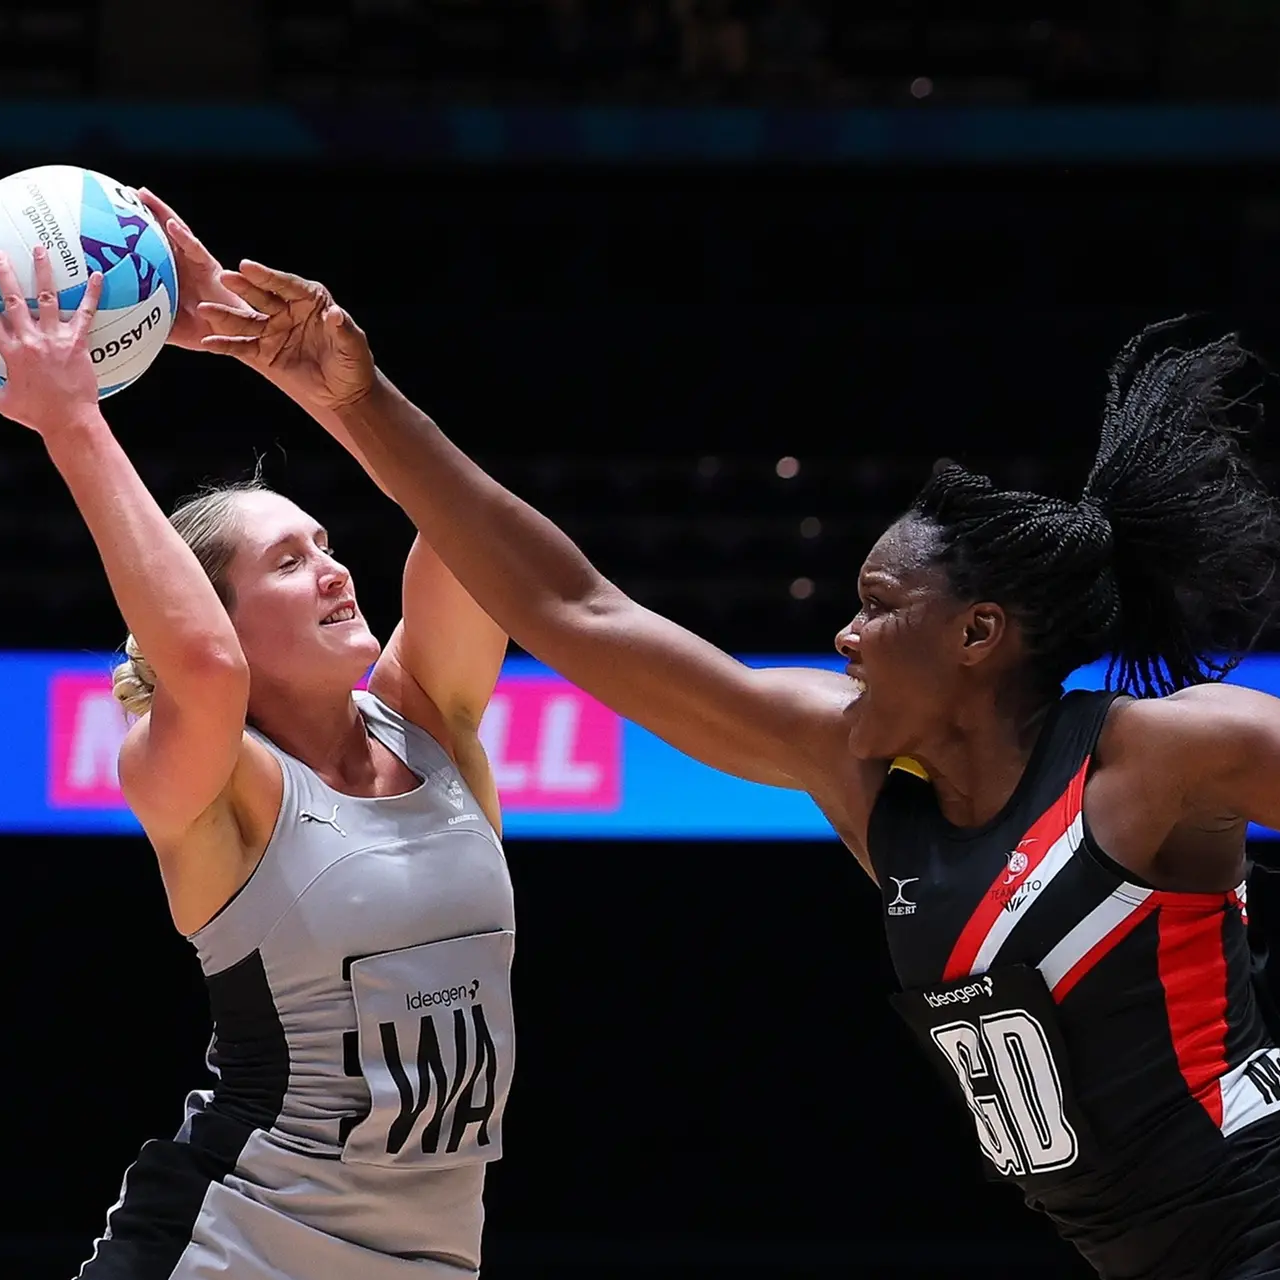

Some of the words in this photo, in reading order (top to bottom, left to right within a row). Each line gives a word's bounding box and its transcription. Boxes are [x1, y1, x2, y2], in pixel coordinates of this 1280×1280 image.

[22, 205, 54, 250] games
[26, 183, 80, 278] commonwealth
[405, 984, 467, 1011] Ideagen
[923, 981, 985, 1009] Ideagen
[378, 1002, 498, 1155] WA
[929, 1008, 1079, 1176] GD
